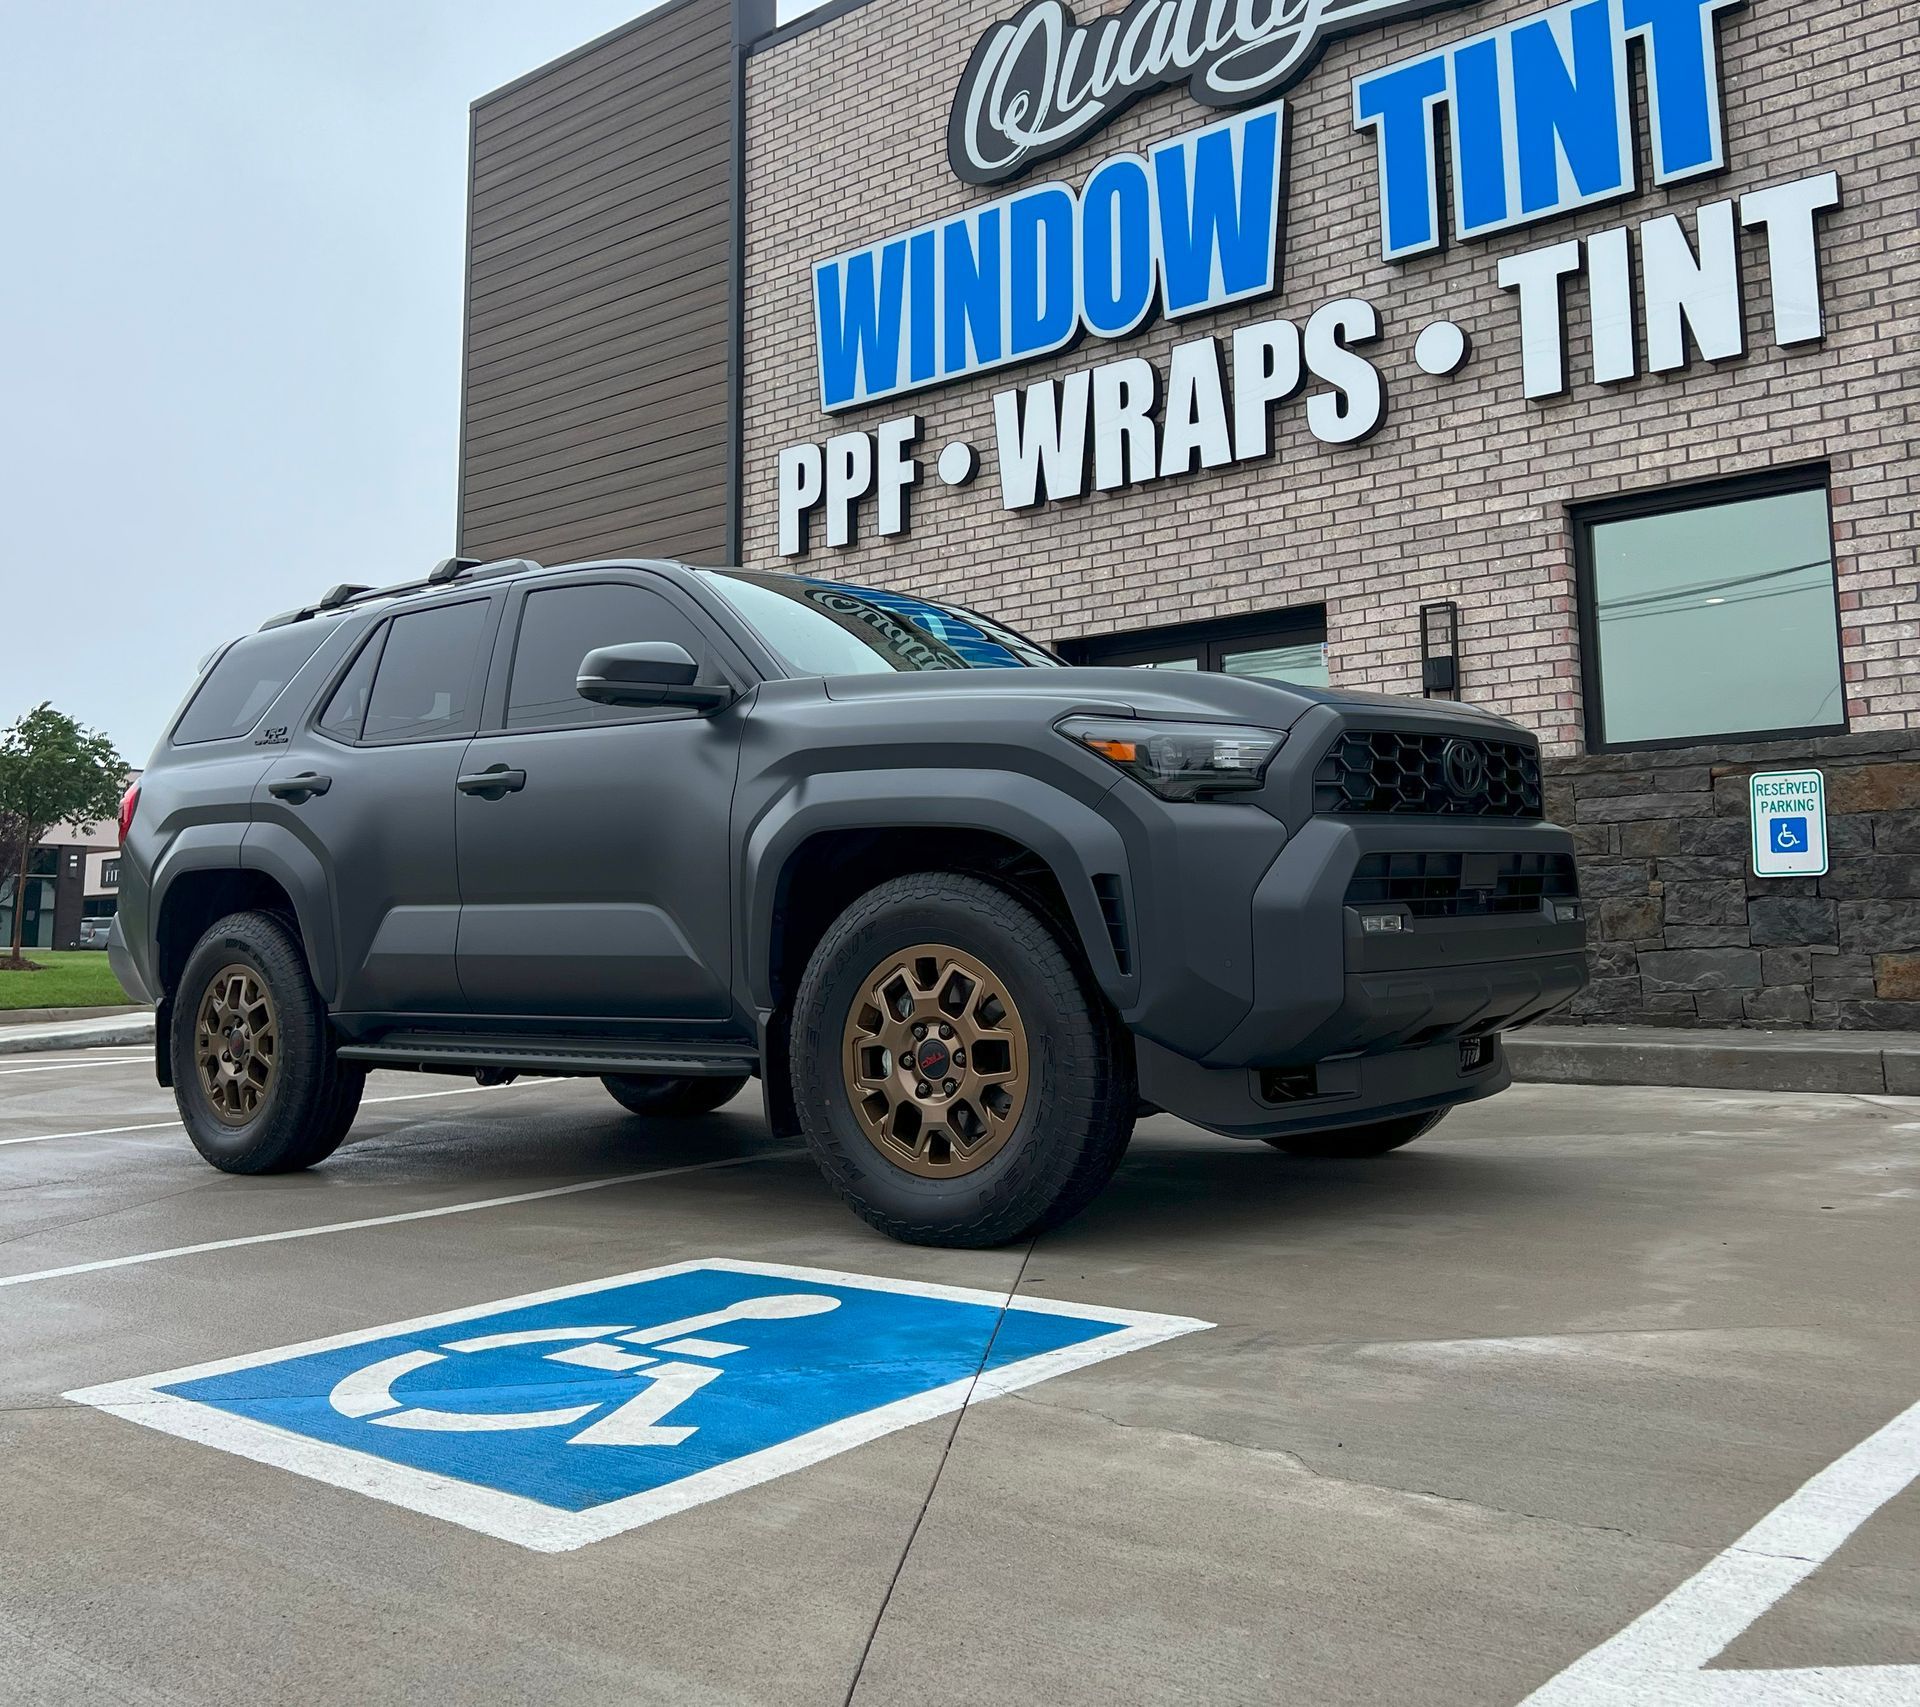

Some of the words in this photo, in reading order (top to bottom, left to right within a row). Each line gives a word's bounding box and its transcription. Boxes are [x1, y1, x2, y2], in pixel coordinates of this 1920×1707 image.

[811, 99, 1284, 414] WINDOW
[1352, 0, 1745, 263] TINT
[778, 414, 917, 557] PPF
[993, 297, 1382, 511] WRAPS
[1497, 170, 1839, 400] TINT
[1756, 780, 1818, 796] RESERVED
[1761, 799, 1815, 813] PARKING
